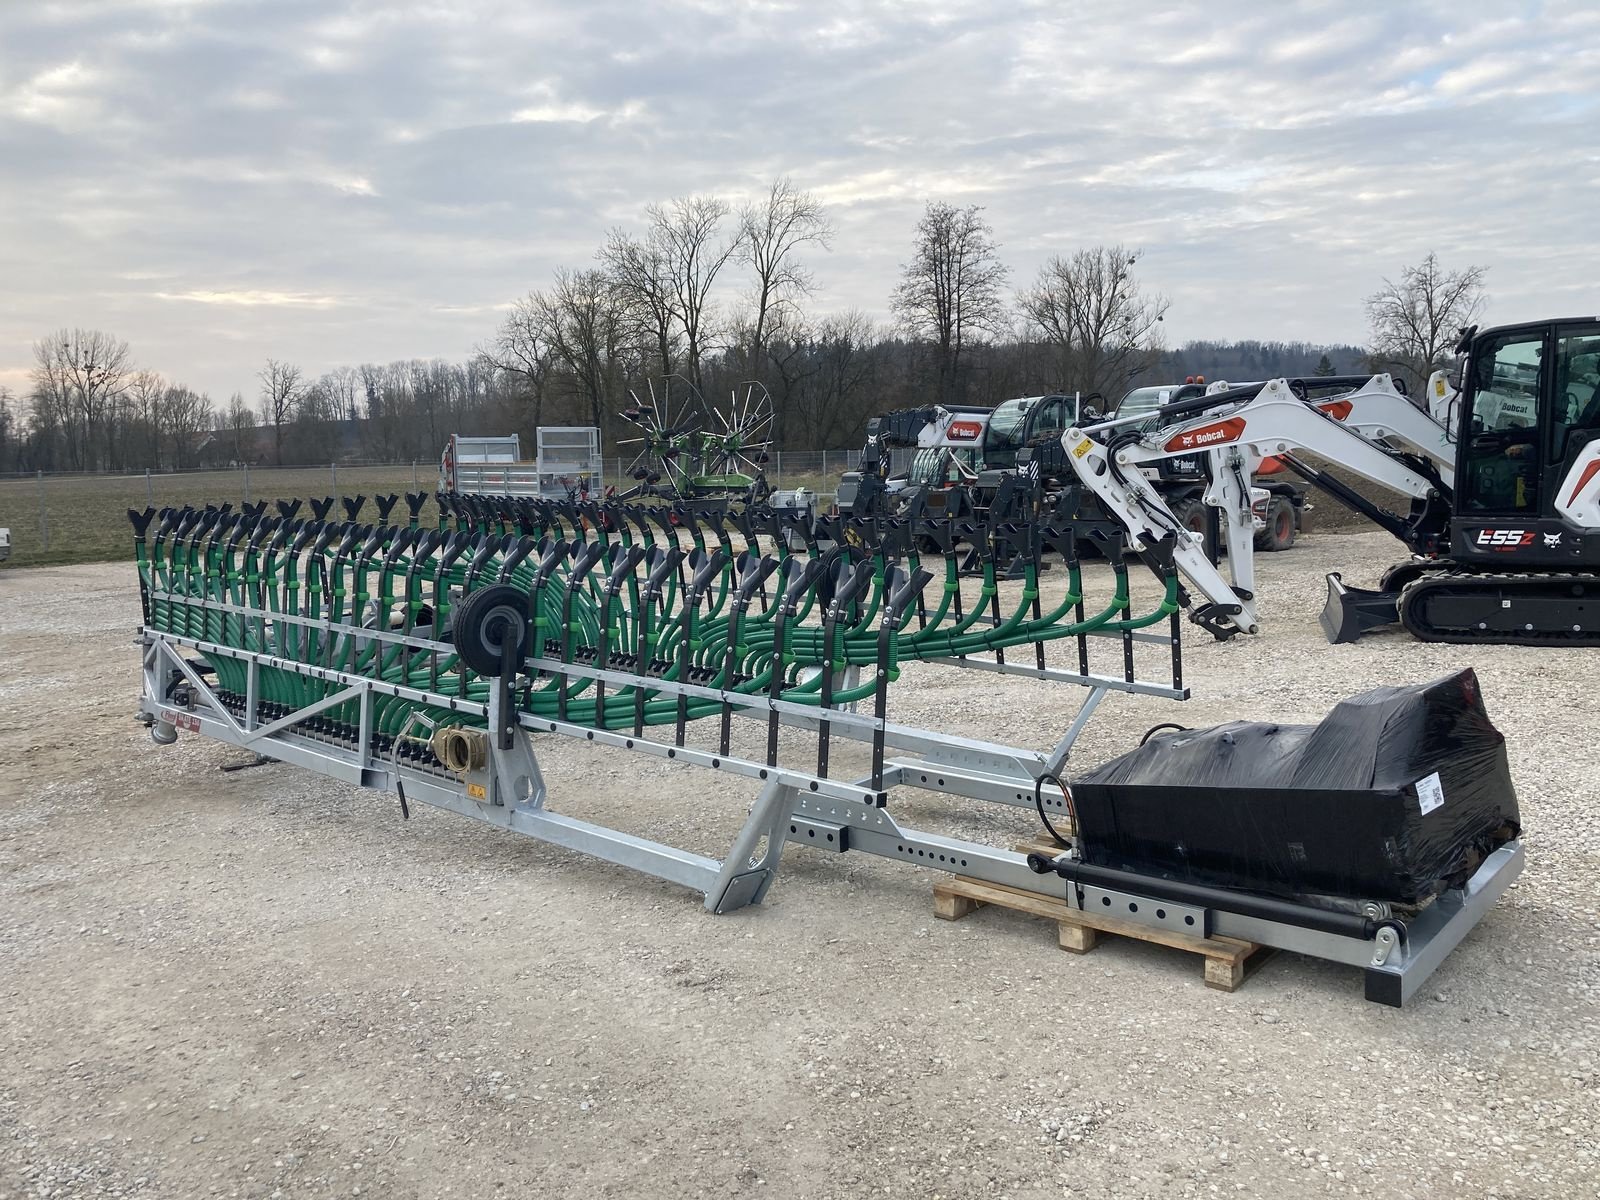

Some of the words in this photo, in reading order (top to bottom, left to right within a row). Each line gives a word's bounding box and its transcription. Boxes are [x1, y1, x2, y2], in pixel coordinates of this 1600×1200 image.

[1501, 403, 1528, 413] Bobcat
[960, 428, 975, 437] Bobcat
[1196, 429, 1225, 444] Bobcat
[1180, 460, 1195, 469] Bobcat
